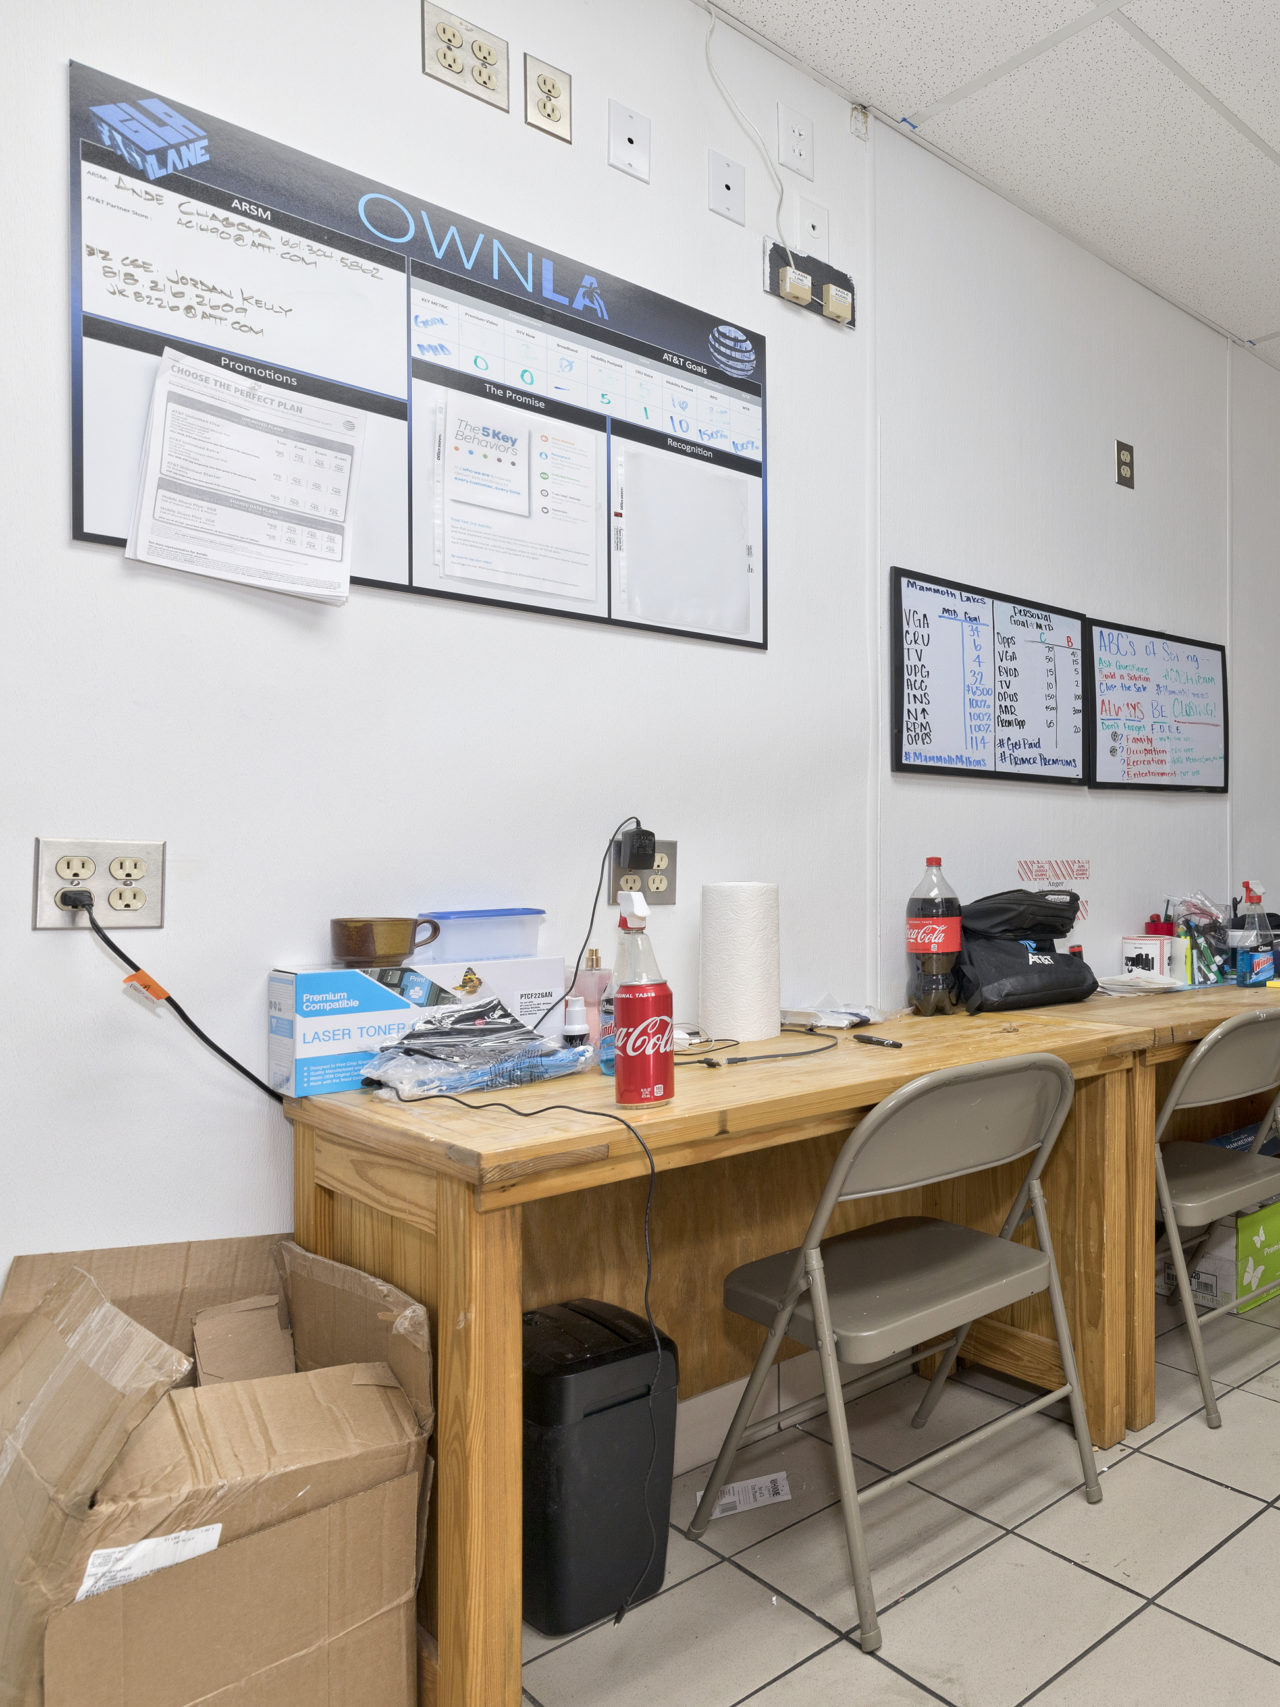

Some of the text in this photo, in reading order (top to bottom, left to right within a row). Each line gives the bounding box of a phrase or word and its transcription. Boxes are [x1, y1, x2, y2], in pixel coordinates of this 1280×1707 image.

[231, 199, 271, 221] ARSM
[220, 356, 299, 387] Promotions
[662, 352, 708, 375] AT&T Goals
[170, 364, 304, 414] CHOOSE THE PERFECT PLAN
[484, 383, 546, 409] The Promise
[458, 418, 519, 447] The 5 Key
[454, 429, 519, 457] Behaviors
[667, 438, 713, 459] Recognition
[959, 591, 987, 605] Lakes
[904, 607, 930, 629] VGA
[904, 630, 930, 647] CRU
[1066, 635, 1074, 649] B
[906, 647, 924, 662] TV
[905, 664, 930, 679] UPG
[999, 680, 1011, 690] TV
[906, 692, 931, 706] INS
[905, 720, 932, 735] RPM
[970, 736, 990, 751] 114
[409, 975, 427, 983] Print
[302, 998, 359, 1012] Compatible
[303, 991, 348, 1003] Premium
[302, 1028, 352, 1045] LASER
